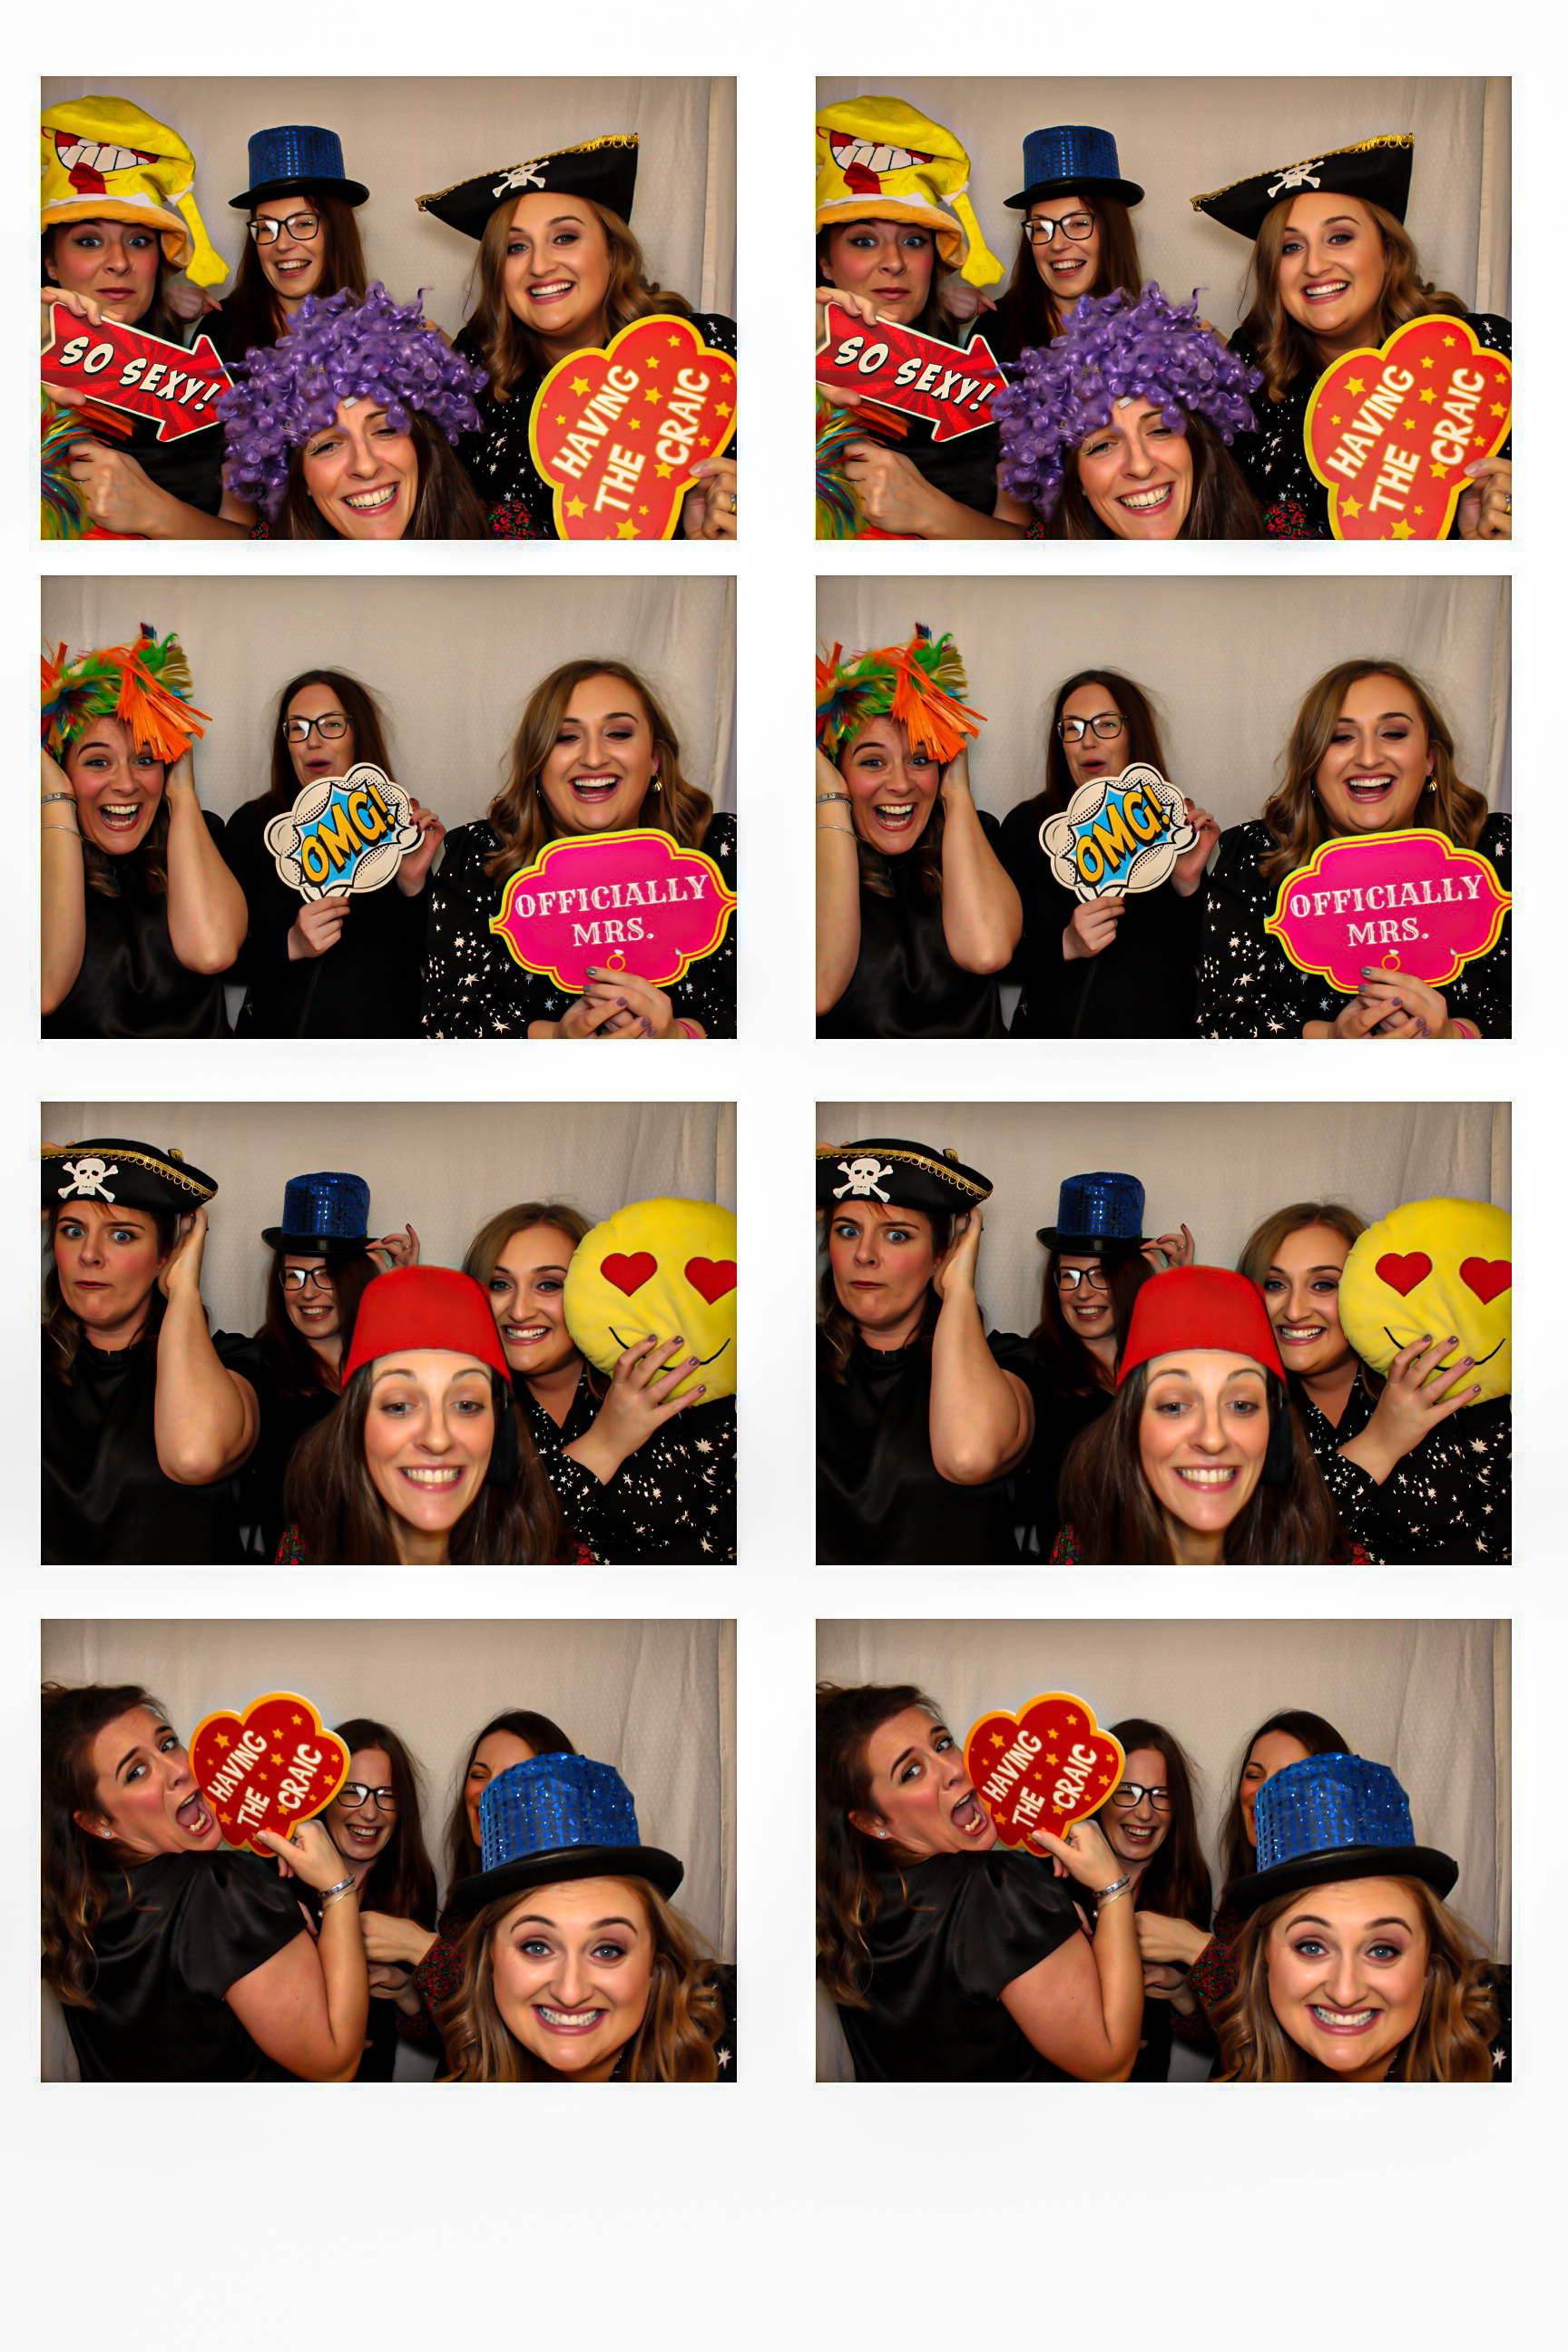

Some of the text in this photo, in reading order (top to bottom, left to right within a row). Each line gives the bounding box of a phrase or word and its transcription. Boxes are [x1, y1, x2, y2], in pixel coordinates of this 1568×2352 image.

[59, 336, 220, 411] SO SEXY!
[834, 336, 995, 411] SO SEXY!
[551, 366, 640, 479] HAVING
[656, 368, 710, 466] CRAIC
[1326, 366, 1415, 479] HAVING
[1431, 368, 1485, 466] CRAIC
[594, 444, 645, 513] THE
[1369, 444, 1420, 513] THE
[301, 783, 397, 885] OMG!
[1076, 783, 1171, 885] OMG!
[515, 875, 708, 917] OFFICIALLY
[573, 916, 654, 946] MRS.
[1290, 875, 1483, 917] OFFICIALLY
[1348, 916, 1429, 946] MRS.
[208, 1730, 268, 1802] HAVING
[278, 1744, 322, 1809] CRAIC
[983, 1730, 1043, 1802] HAVING
[1053, 1744, 1097, 1809] CRAIC
[237, 1787, 270, 1828] THE
[1012, 1787, 1045, 1828] THE
